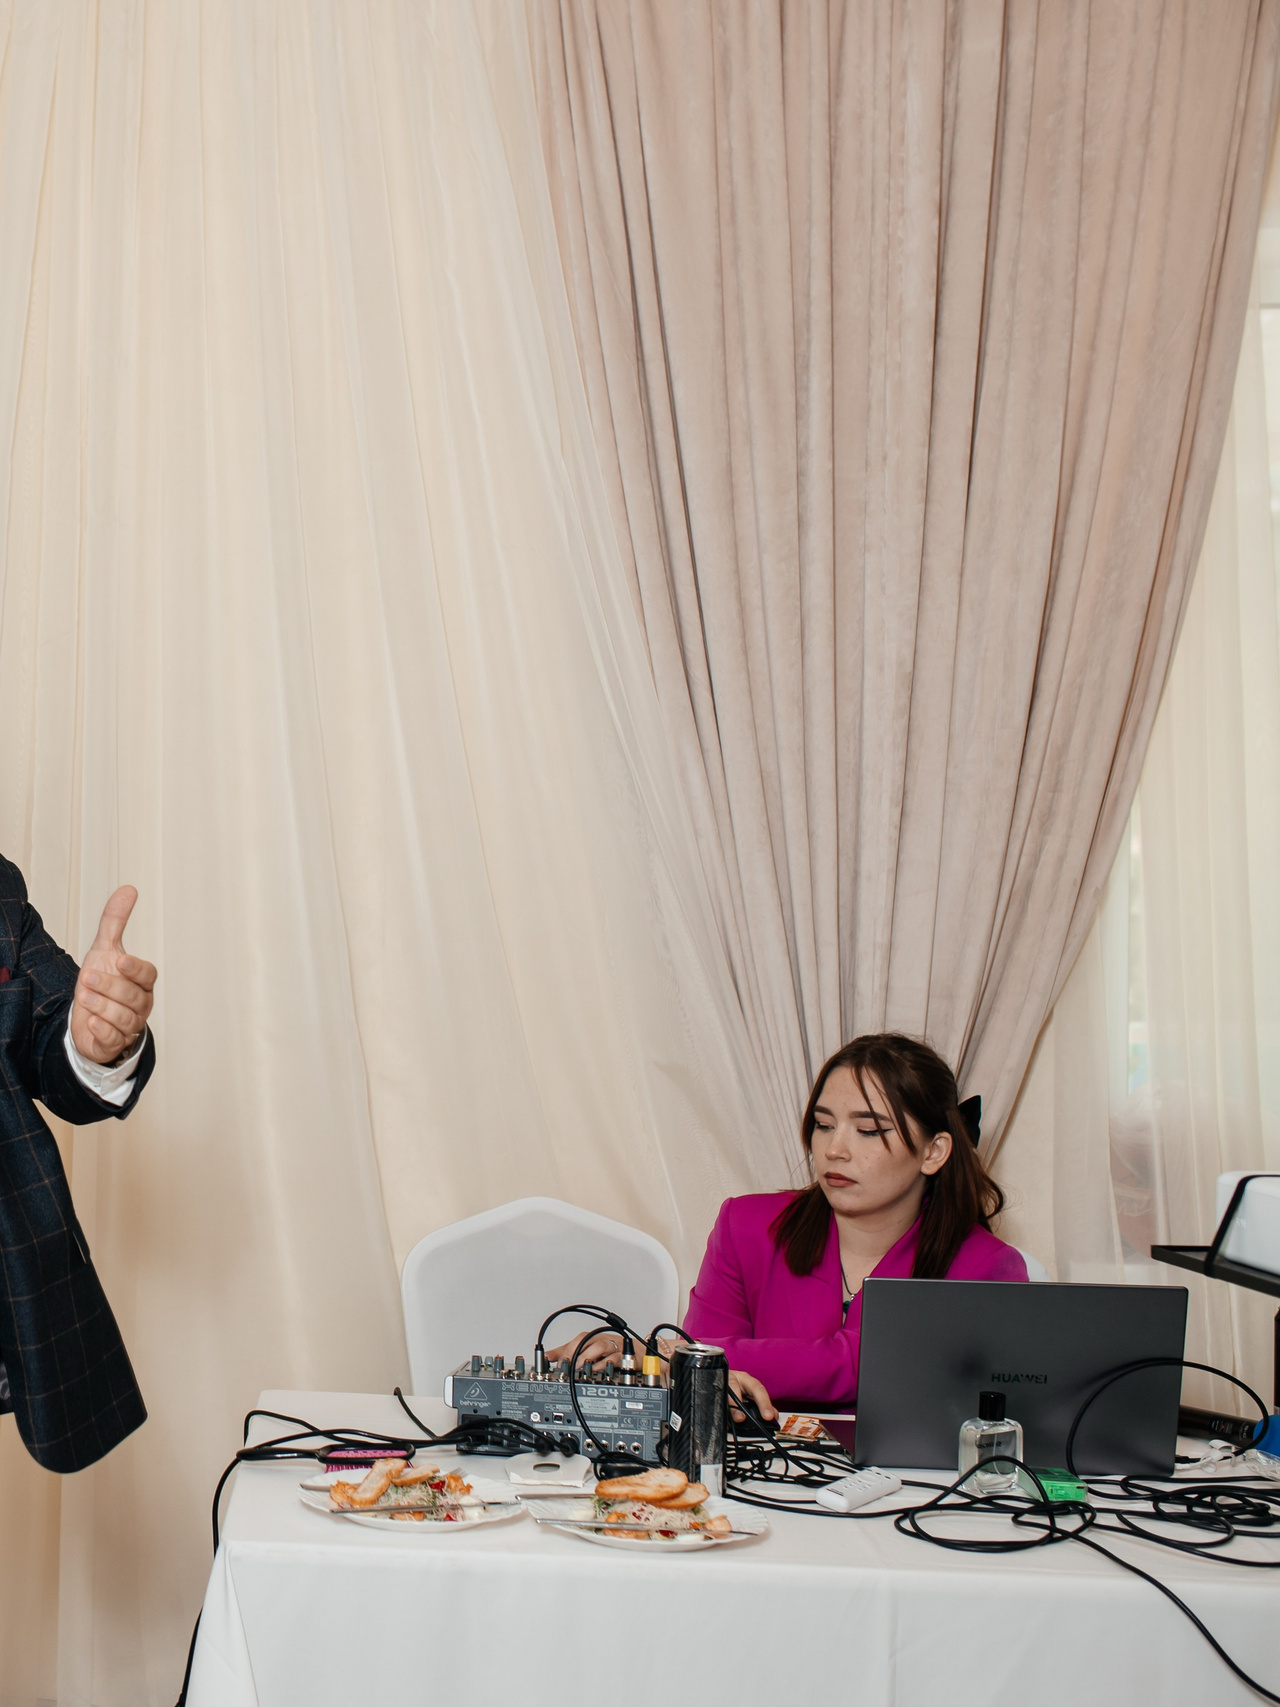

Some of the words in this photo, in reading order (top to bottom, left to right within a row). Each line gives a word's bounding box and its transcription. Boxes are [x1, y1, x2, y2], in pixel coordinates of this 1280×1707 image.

[991, 1373, 1048, 1385] HUAWEI
[501, 1382, 571, 1394] XENYX
[460, 1399, 491, 1409] behringer
